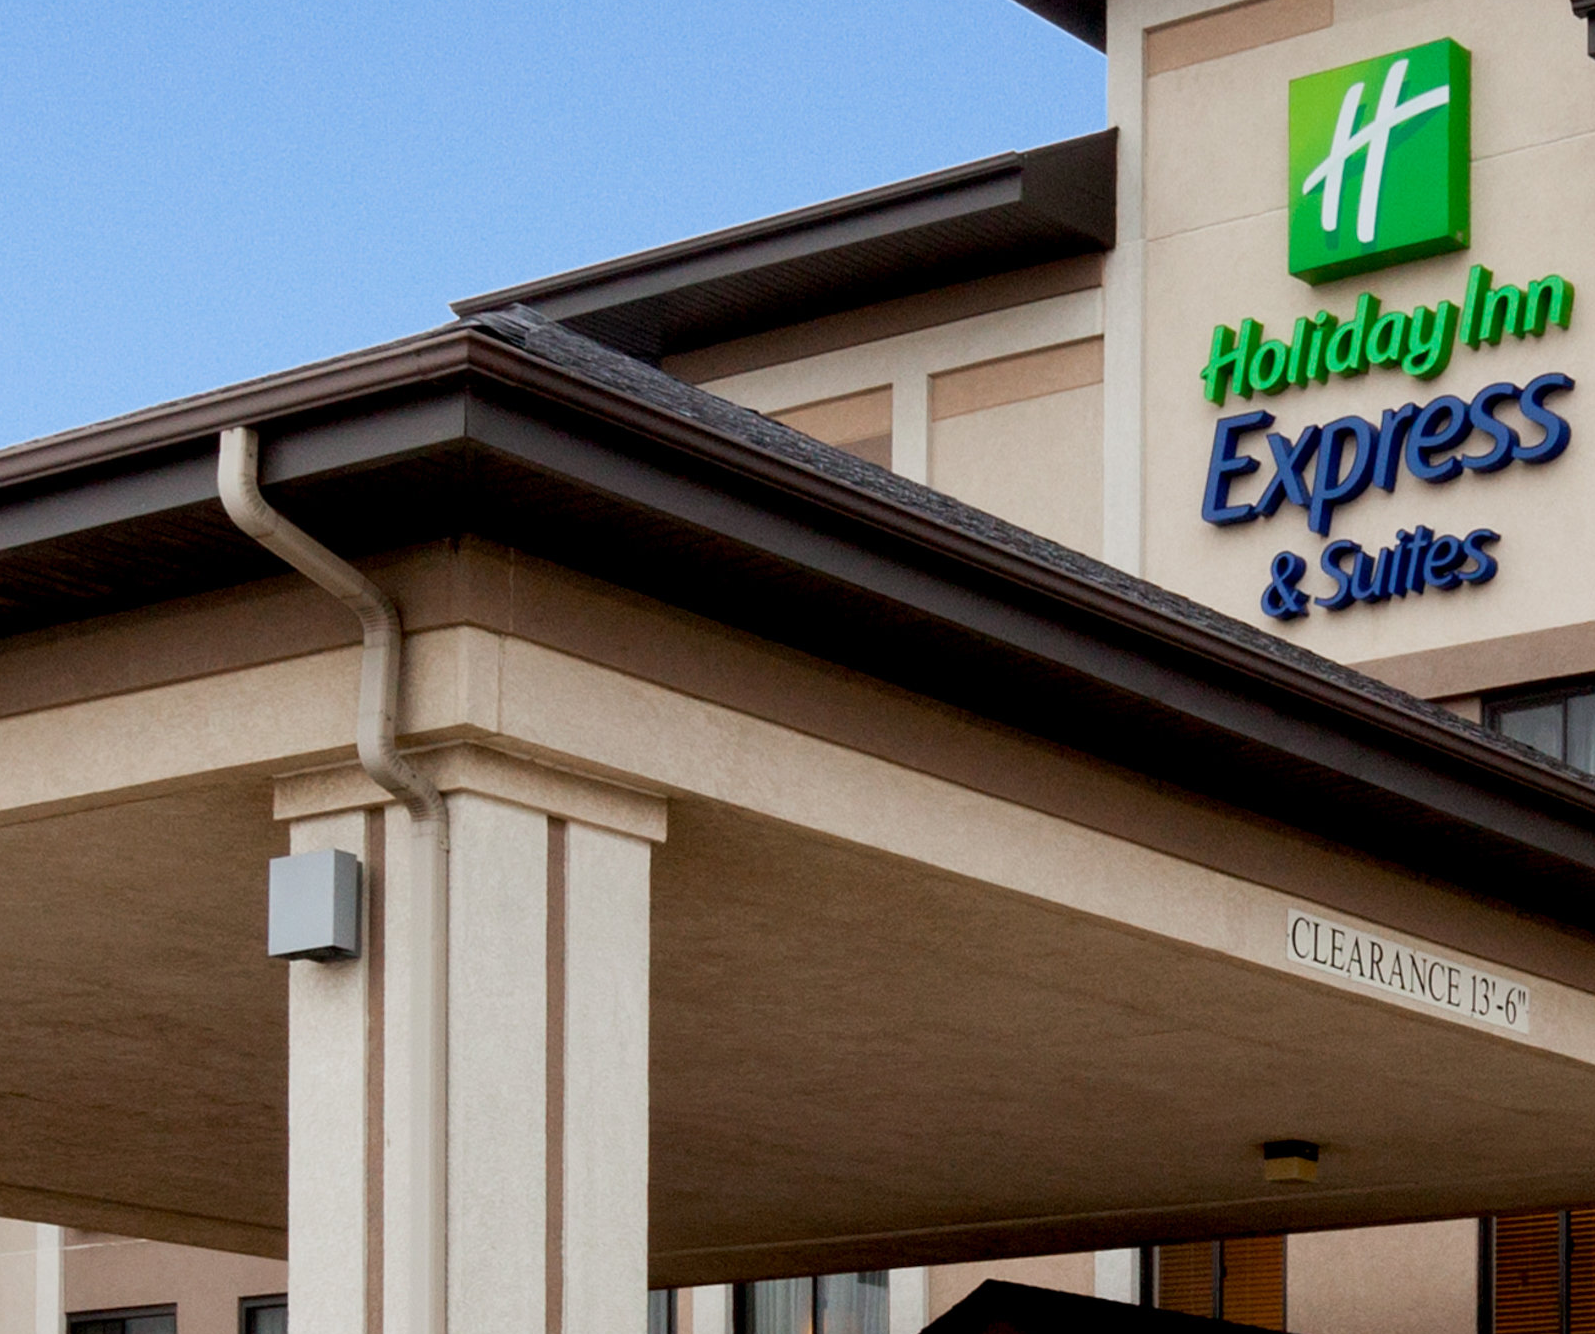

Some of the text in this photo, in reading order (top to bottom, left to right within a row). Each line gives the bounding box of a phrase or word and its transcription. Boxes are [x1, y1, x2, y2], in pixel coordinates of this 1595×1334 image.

[1202, 265, 1574, 404] Holiday Inn
[1202, 372, 1575, 536] Express
[1261, 525, 1500, 621] & Suites
[1291, 917, 1526, 1024] CLEARANCE 13'-6"
